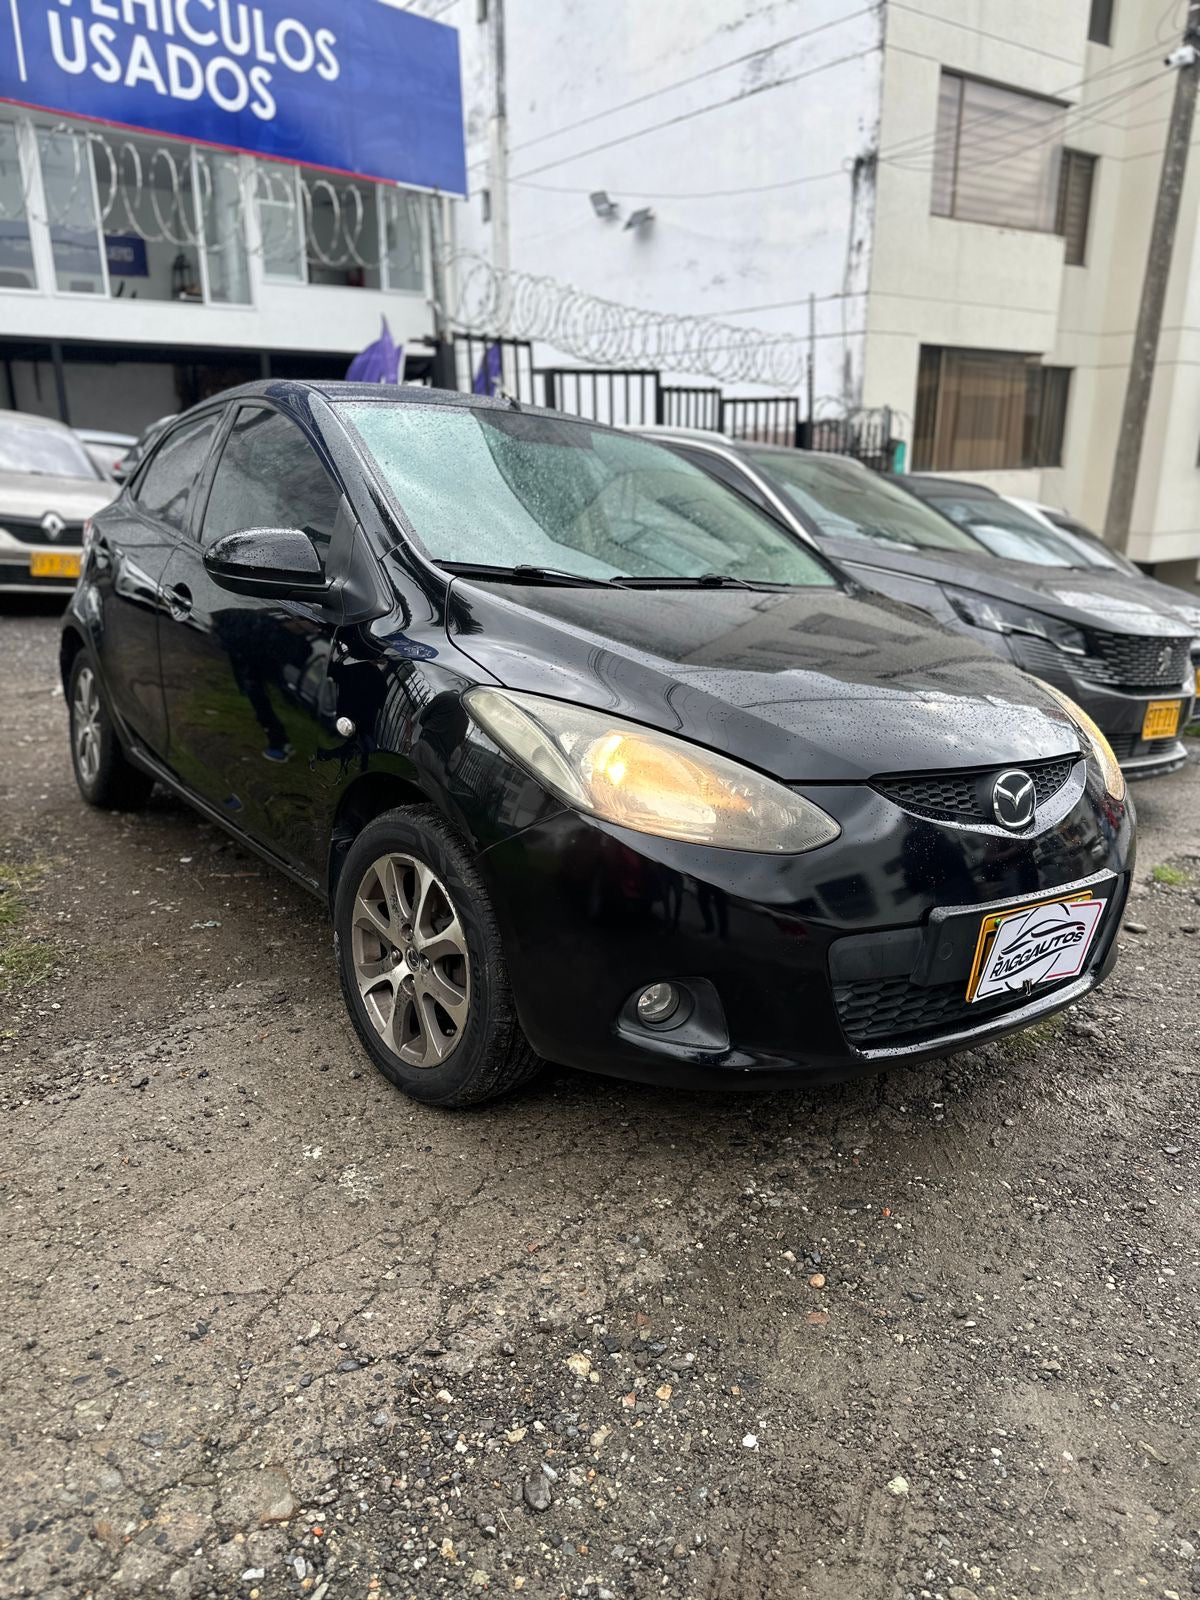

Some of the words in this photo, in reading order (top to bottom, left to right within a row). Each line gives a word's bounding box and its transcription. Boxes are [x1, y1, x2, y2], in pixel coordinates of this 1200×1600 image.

[47, 9, 276, 121] USADOS
[58, 0, 340, 82] HICULOS
[989, 931, 1085, 979] RAGGAUTOS
